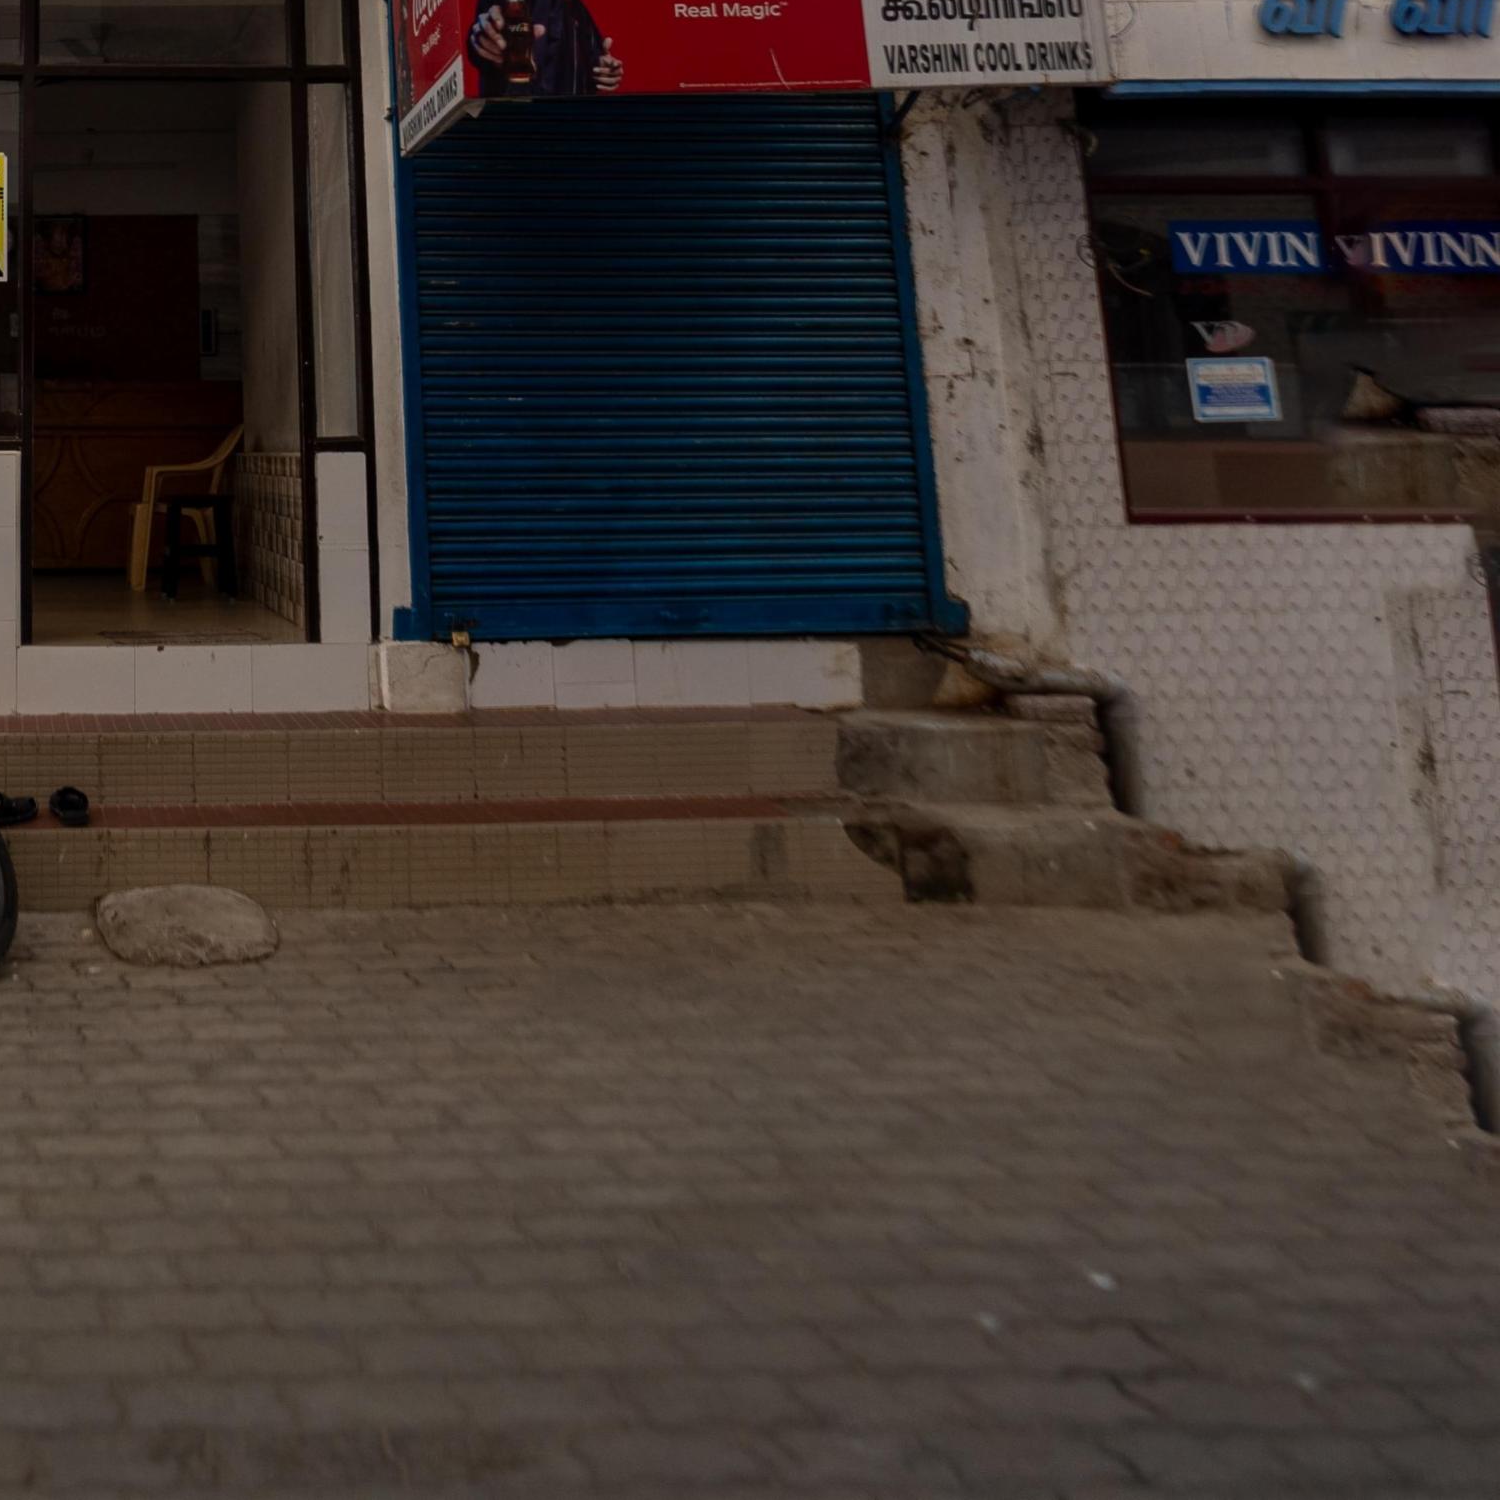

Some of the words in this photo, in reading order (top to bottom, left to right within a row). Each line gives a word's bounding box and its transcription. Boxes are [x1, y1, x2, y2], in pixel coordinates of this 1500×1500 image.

[674, 3, 718, 18] Real
[722, 2, 782, 20] Magic
[883, 43, 970, 74] VARSHINI
[974, 42, 1023, 73] COOL
[1025, 41, 1093, 71] DRINKS
[422, 91, 436, 125] COOL
[436, 70, 459, 114] DRINKS
